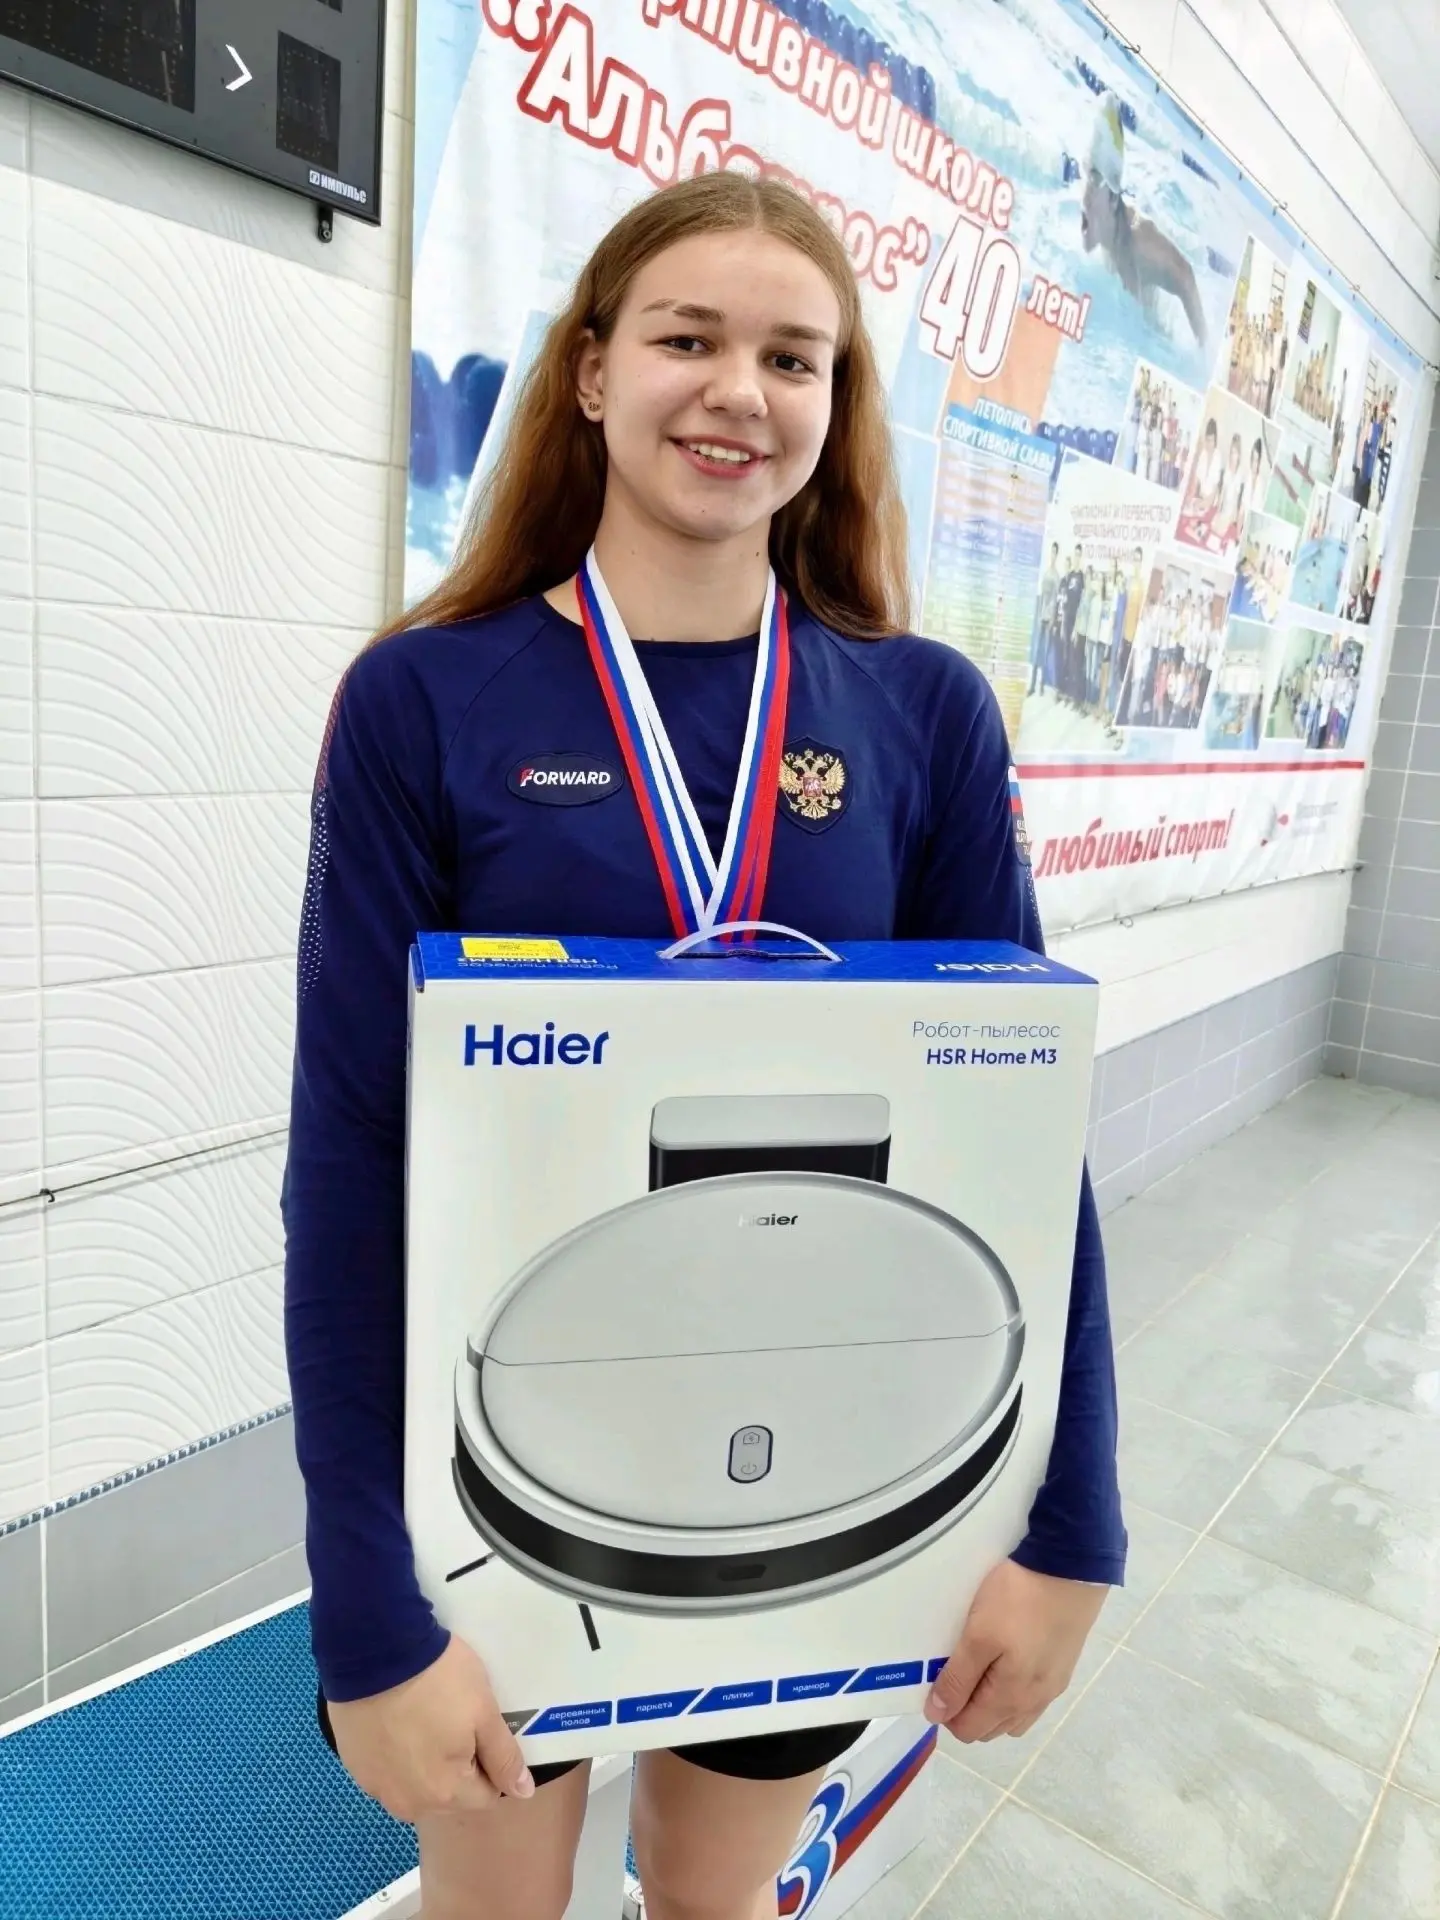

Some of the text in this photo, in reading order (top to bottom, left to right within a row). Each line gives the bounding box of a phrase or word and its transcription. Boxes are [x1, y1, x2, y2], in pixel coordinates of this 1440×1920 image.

[893, 106, 1015, 230] школе
[320, 173, 368, 204] ИМПУЛЬС
[481, 0, 1092, 380] “Альбос” 40 лет!
[973, 397, 1033, 436] ЛЕТОПИСЬ
[942, 414, 1021, 461] СПОРТИВНОЙ
[519, 768, 611, 787] FORWARD
[1034, 815, 1165, 879] любимый
[1164, 807, 1236, 864] спорт!
[934, 963, 1052, 972] Haier
[912, 1020, 1061, 1039] Робот-пылесос
[464, 1021, 610, 1066] Haier
[926, 1048, 1058, 1065] HSR Home M3
[875, 1671, 906, 1682] ковров
[723, 1690, 754, 1702] плитки
[793, 1681, 830, 1693] мрамора
[549, 1706, 606, 1721] деревянных
[635, 1701, 673, 1713] паркета
[561, 1717, 591, 1728] полов
